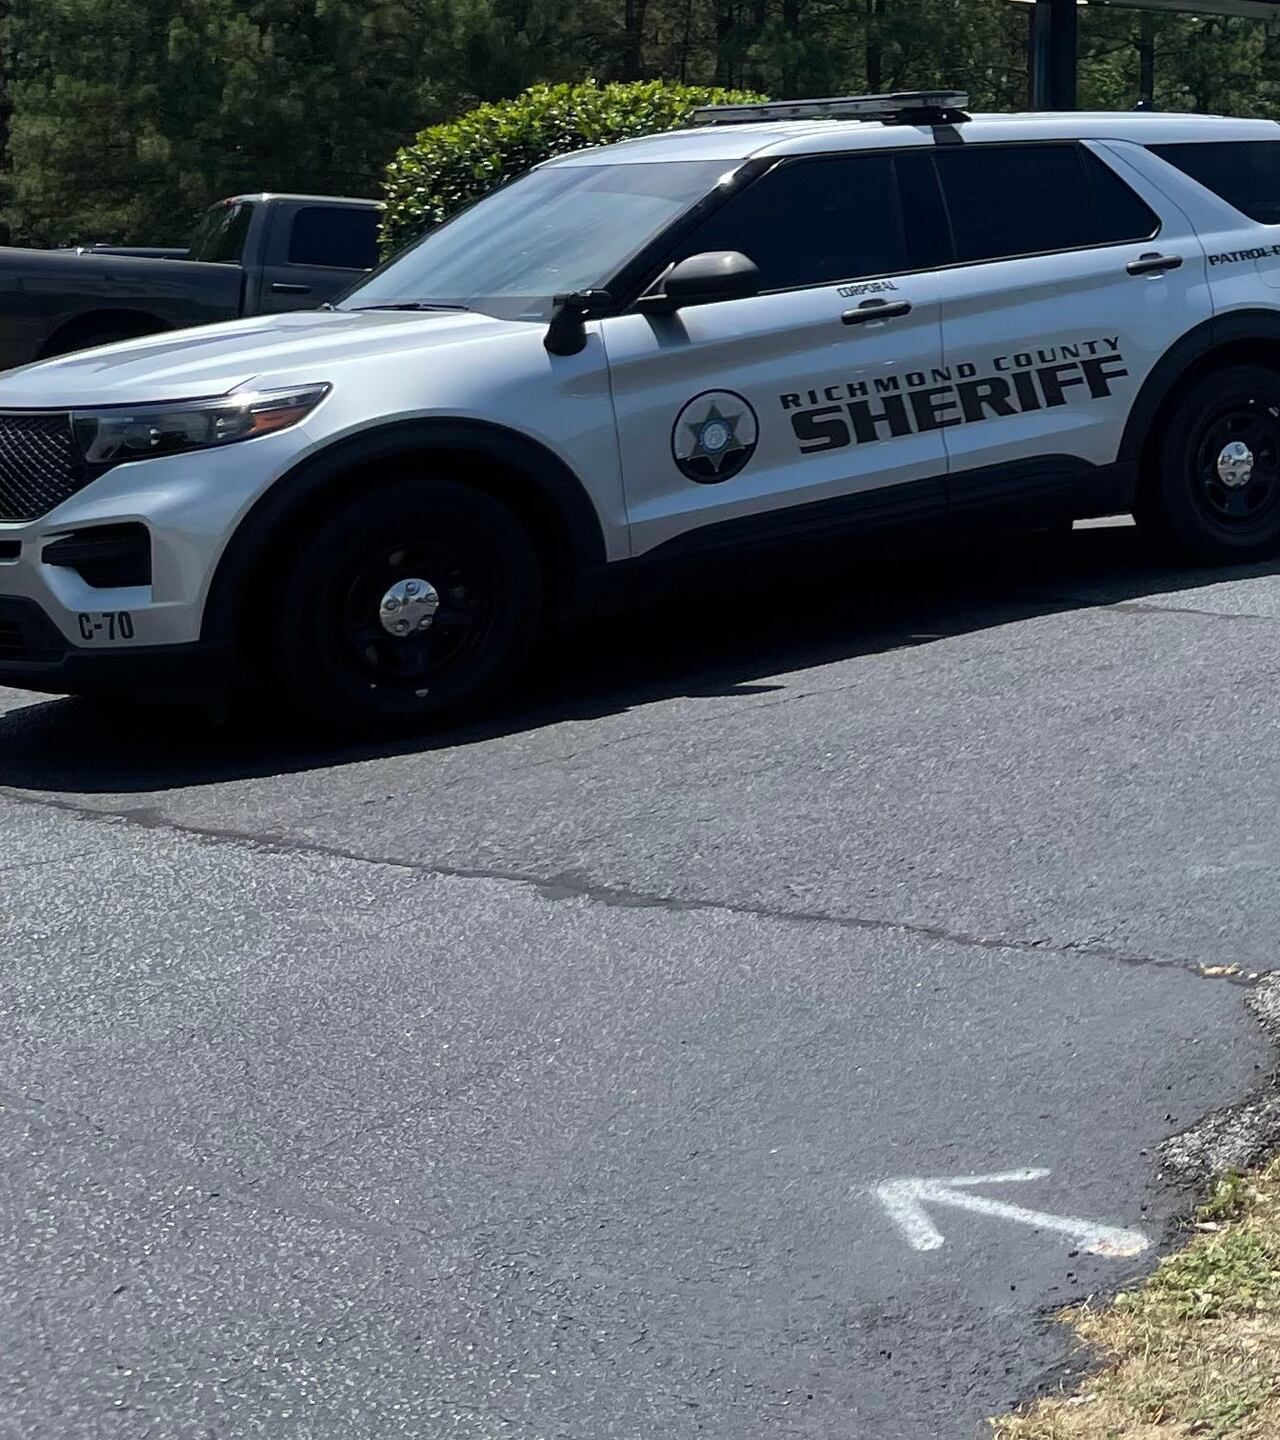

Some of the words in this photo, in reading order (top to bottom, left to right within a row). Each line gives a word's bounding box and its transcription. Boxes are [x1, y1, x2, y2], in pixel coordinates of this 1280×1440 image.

[1208, 247, 1272, 266] PATROL
[779, 362, 978, 410] RICHMOND
[991, 336, 1121, 372] COUNTY
[791, 354, 1130, 455] SHERIFF
[78, 610, 135, 642] C-70
